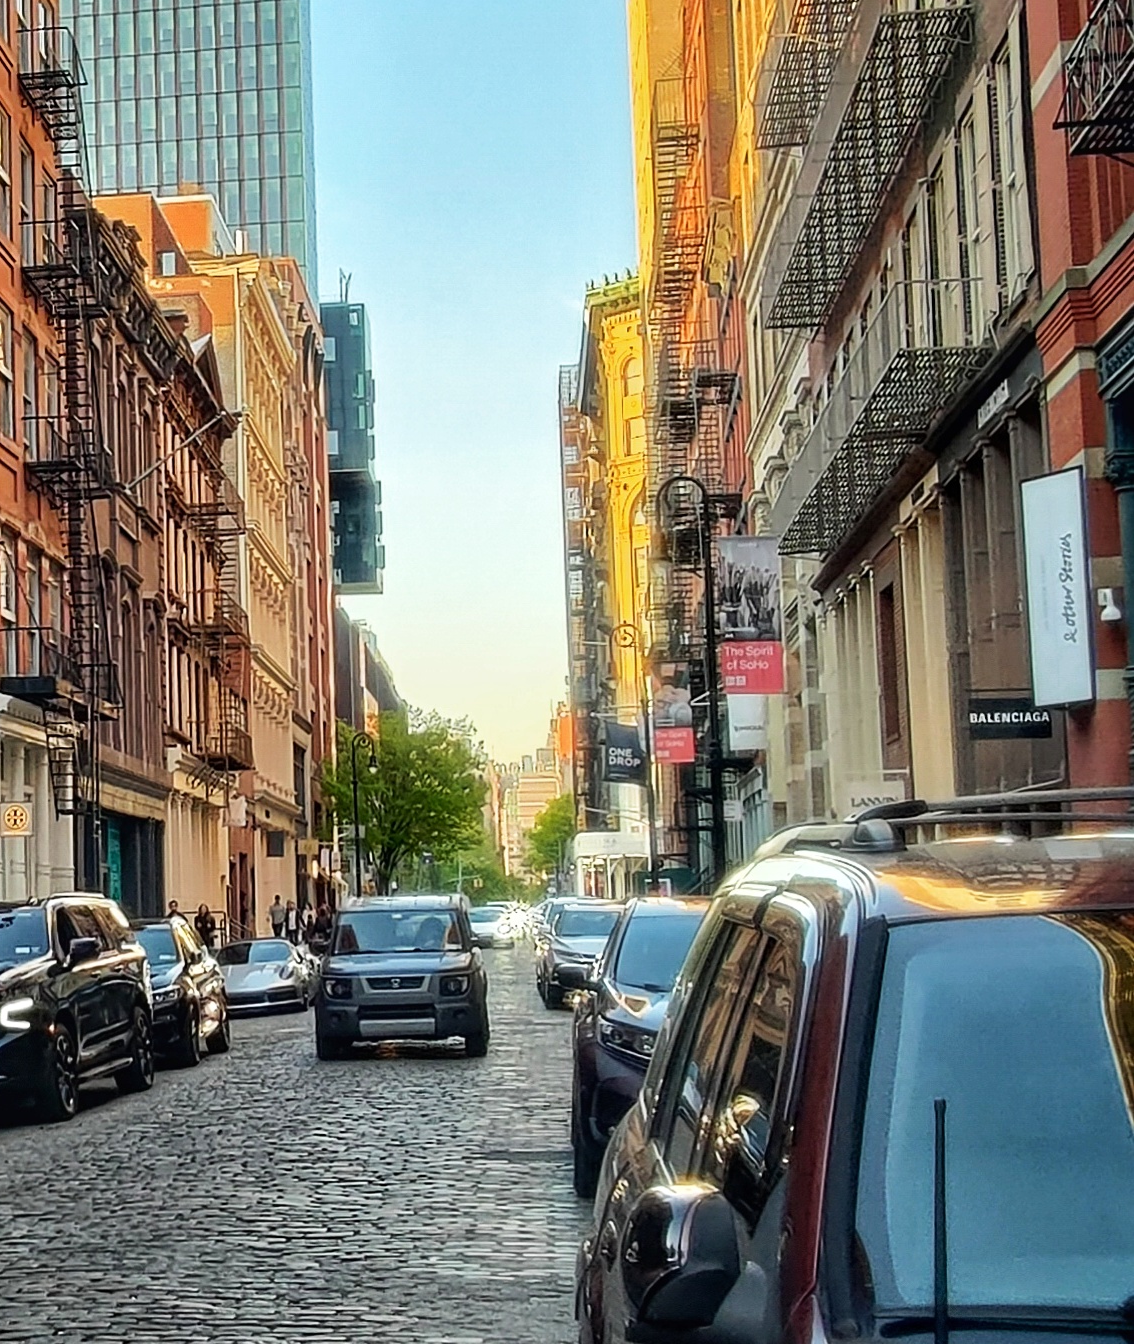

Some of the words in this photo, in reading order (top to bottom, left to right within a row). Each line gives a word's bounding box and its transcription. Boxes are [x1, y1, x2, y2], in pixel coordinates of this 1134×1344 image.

[1063, 628, 1077, 643] &
[724, 646, 744, 656] The
[745, 645, 773, 658] Spirit
[726, 659, 737, 670] of
[739, 659, 769, 670] SoHo
[969, 711, 1050, 723] BALENCIAGA
[609, 747, 633, 757] ONE
[609, 756, 641, 767] DROP
